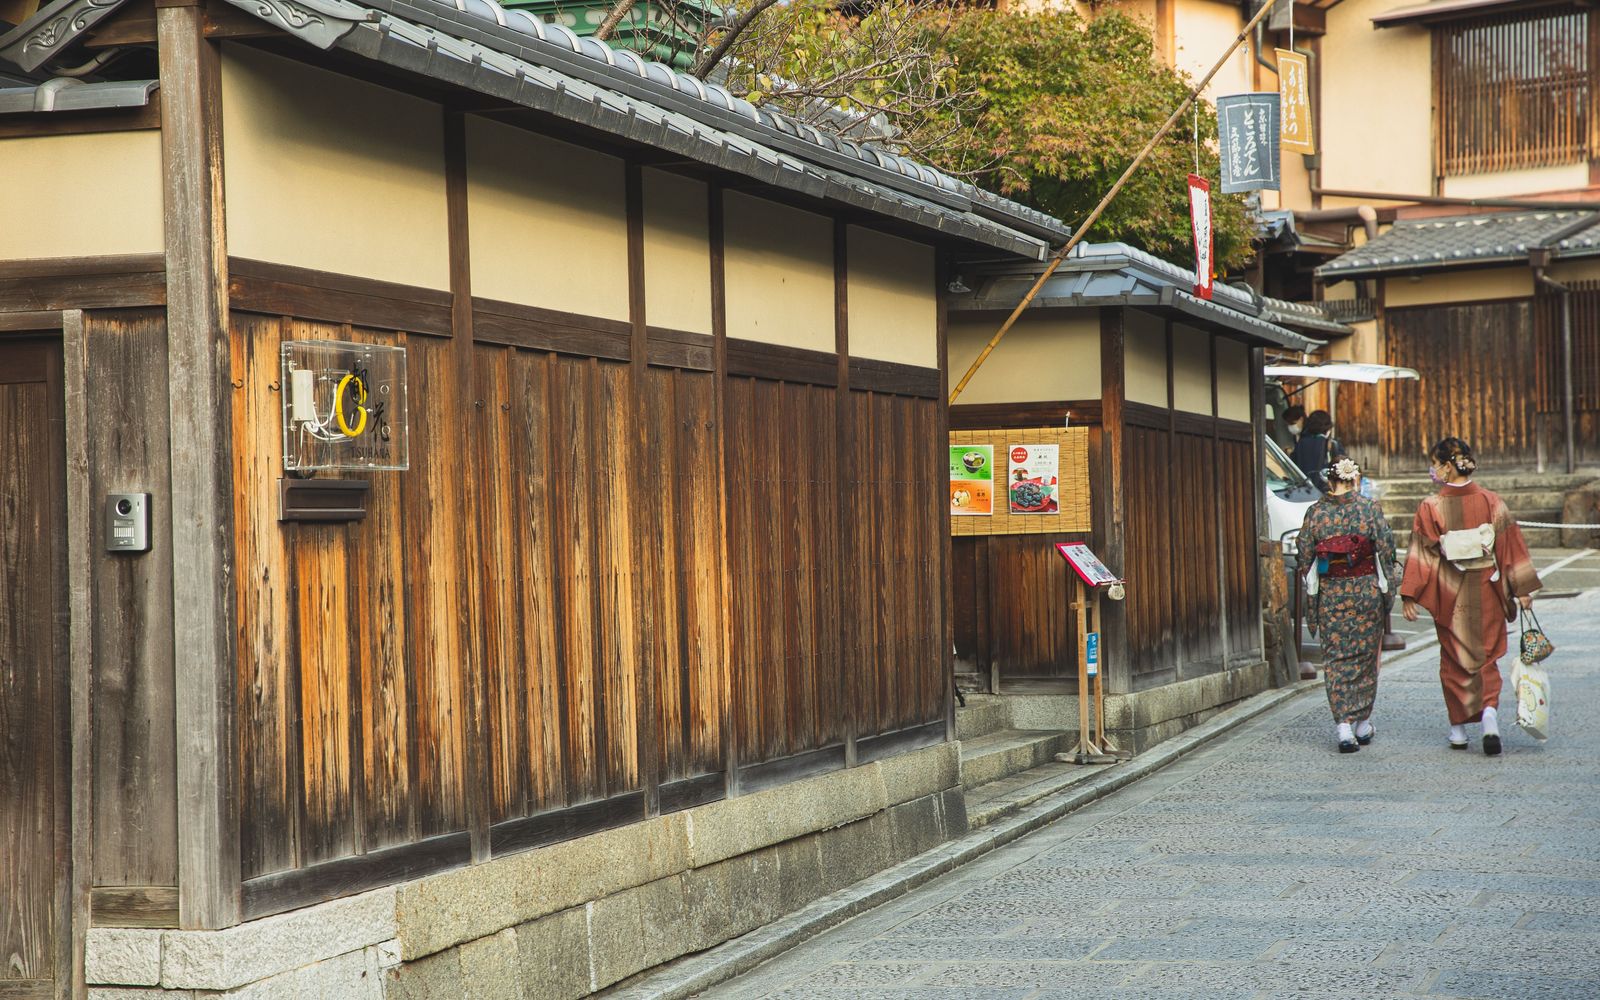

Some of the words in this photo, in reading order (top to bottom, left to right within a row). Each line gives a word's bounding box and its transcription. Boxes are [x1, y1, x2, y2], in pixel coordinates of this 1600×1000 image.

[1288, 63, 1298, 136] あんみつ
[1243, 109, 1260, 177] ところてん
[351, 446, 391, 458] TSUHANA
